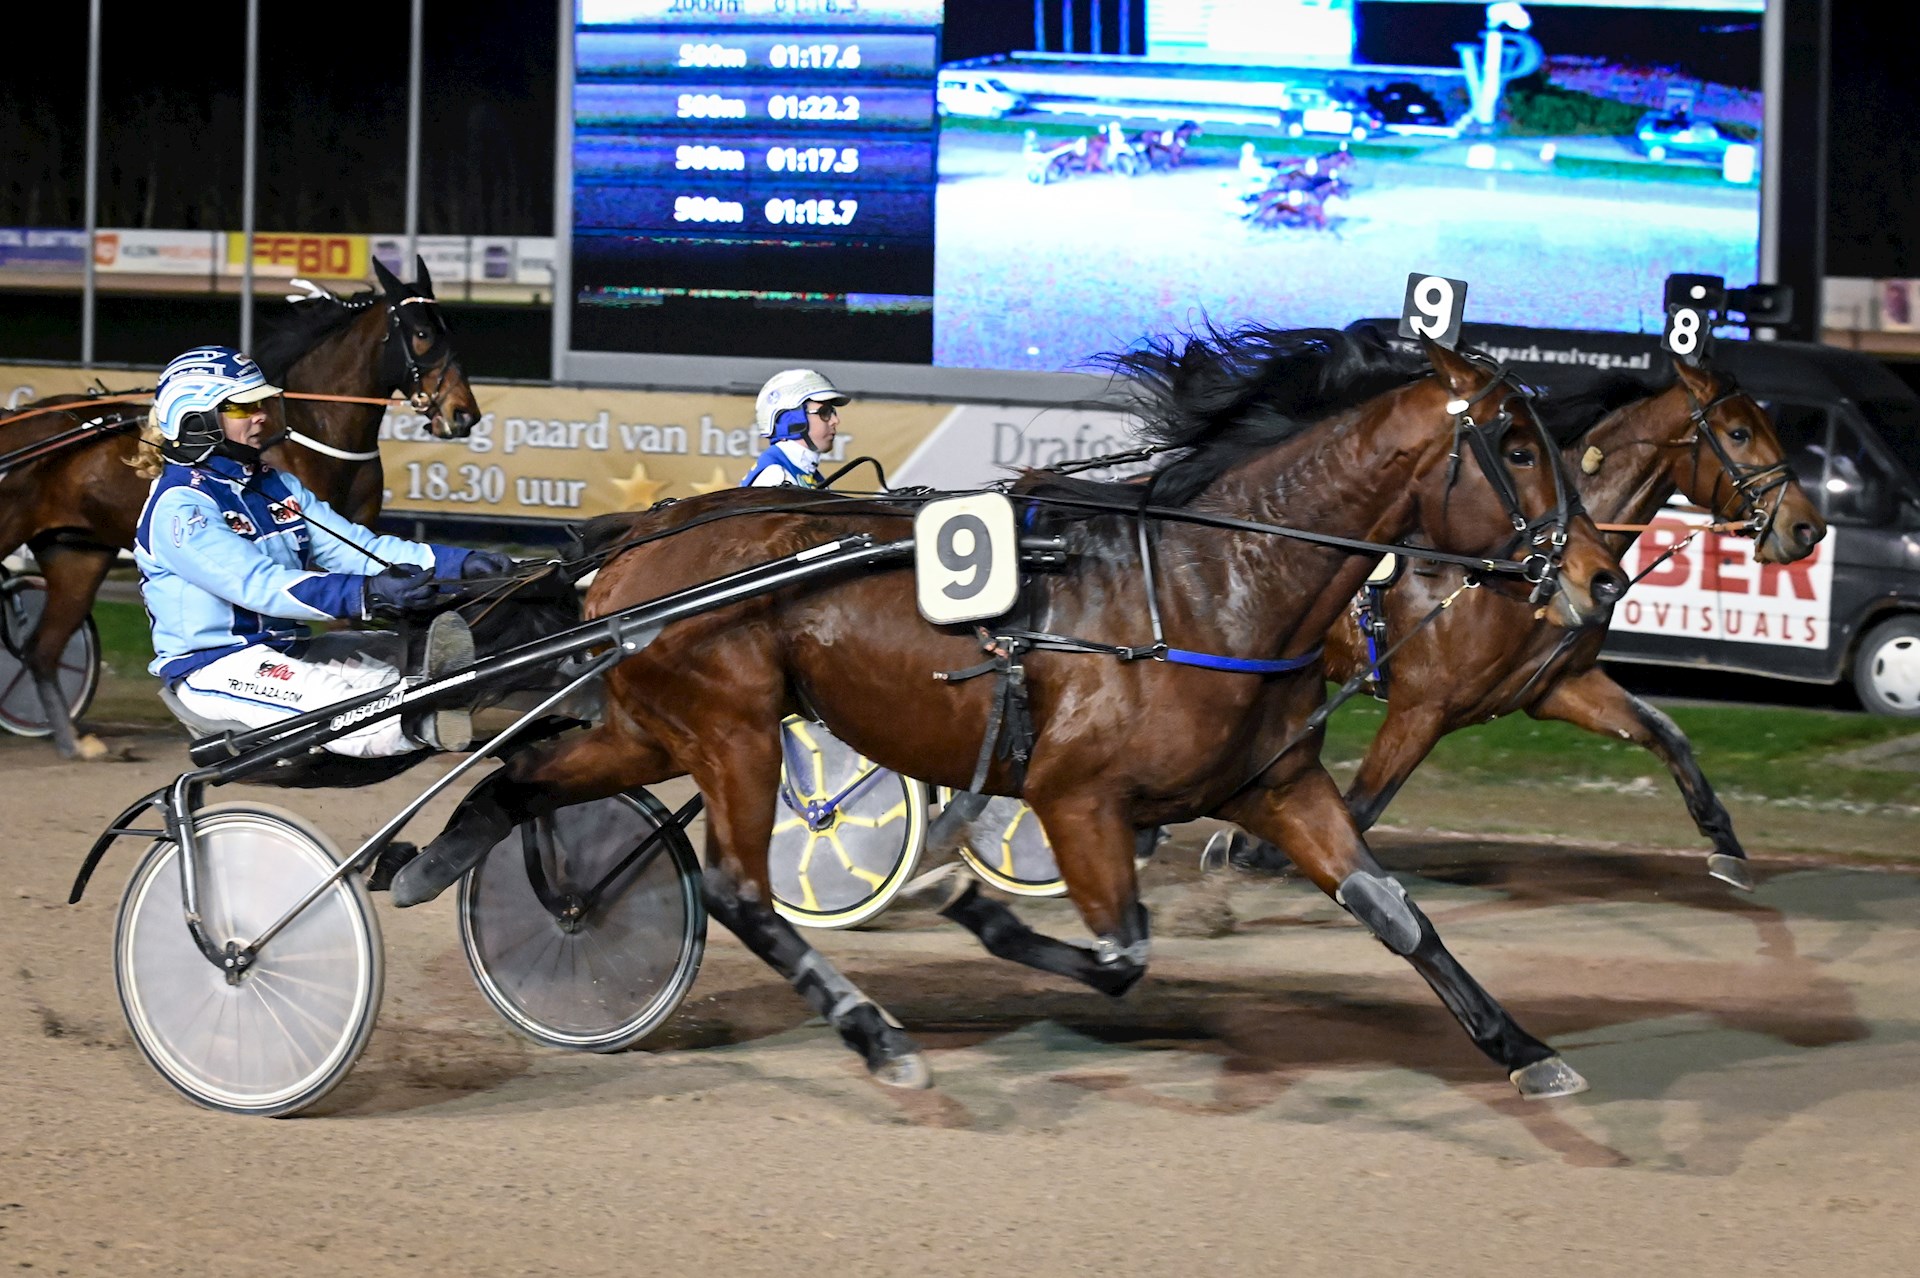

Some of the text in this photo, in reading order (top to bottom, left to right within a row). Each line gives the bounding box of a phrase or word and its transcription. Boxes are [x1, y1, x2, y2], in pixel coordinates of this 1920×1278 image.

[678, 44, 861, 69] 500m 01:17.6
[676, 94, 860, 120] 500m 01:22.2
[675, 145, 859, 173] 500m 01:17.5
[673, 196, 858, 225] 500m 01:15.7
[1409, 276, 1454, 340] 9
[1669, 308, 1700, 355] 8
[504, 408, 611, 454] paard
[618, 423, 688, 454] van
[701, 416, 761, 458] het
[406, 461, 587, 508] 18.30 uur
[936, 514, 993, 600] 9
[1625, 600, 1818, 642] OVISUALS
